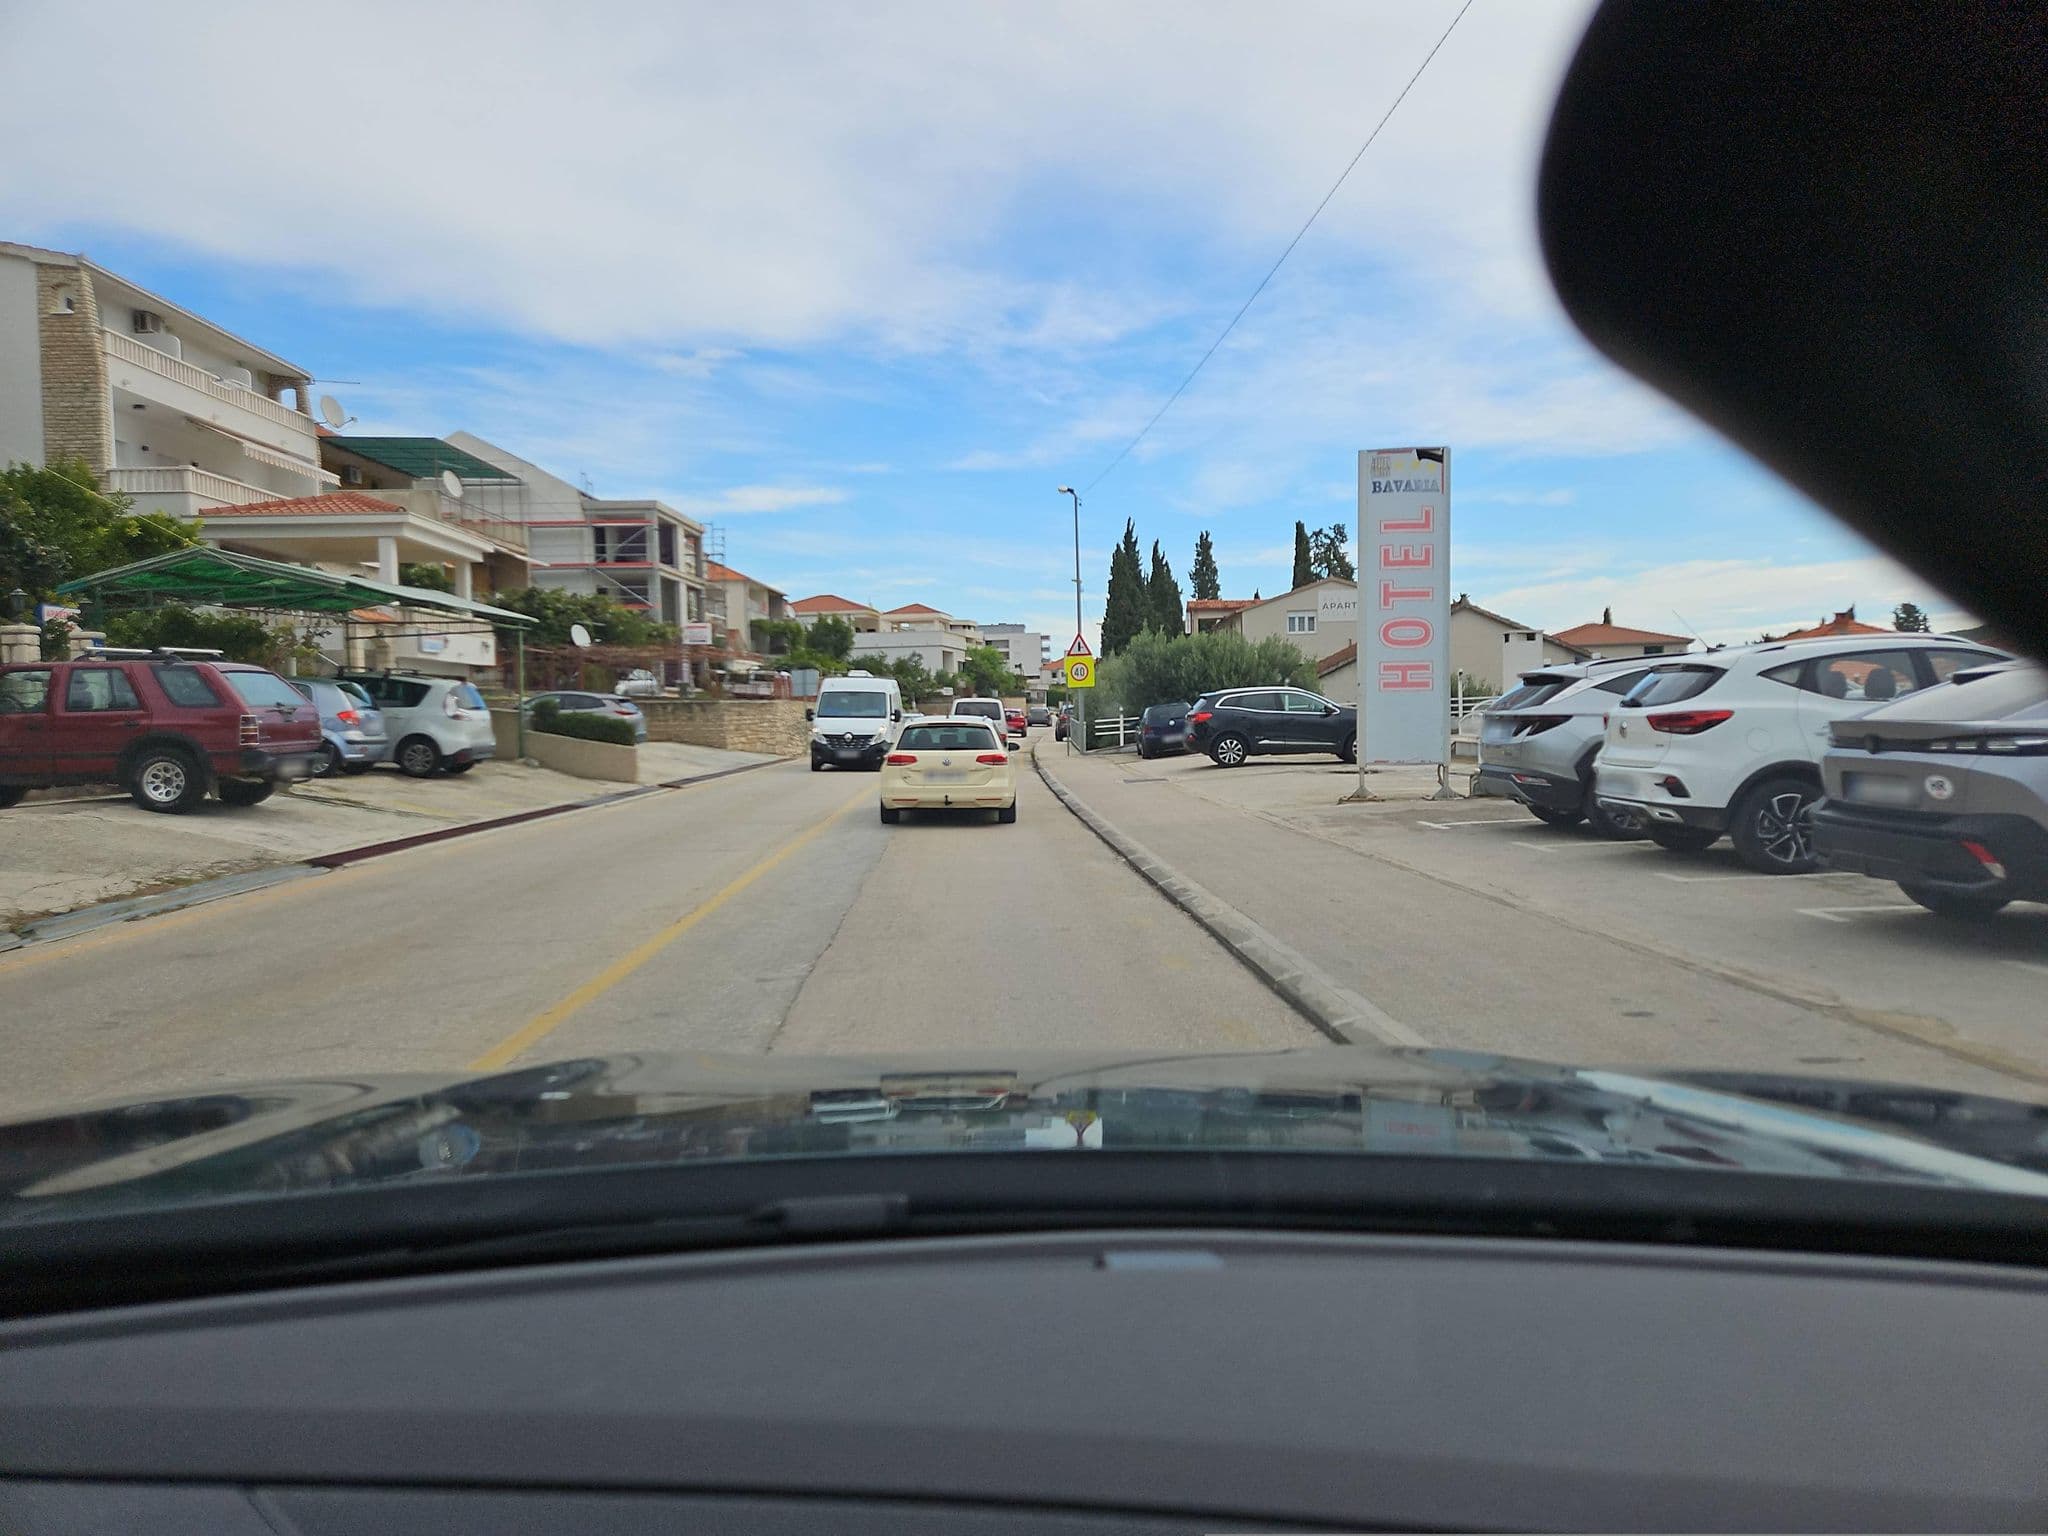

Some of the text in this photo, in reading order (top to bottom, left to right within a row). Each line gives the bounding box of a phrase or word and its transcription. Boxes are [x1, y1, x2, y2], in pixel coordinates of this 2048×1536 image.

[1372, 480, 1439, 494] BAVARIA
[1379, 504, 1435, 692] HOTEL
[1074, 666, 1085, 677] 40
